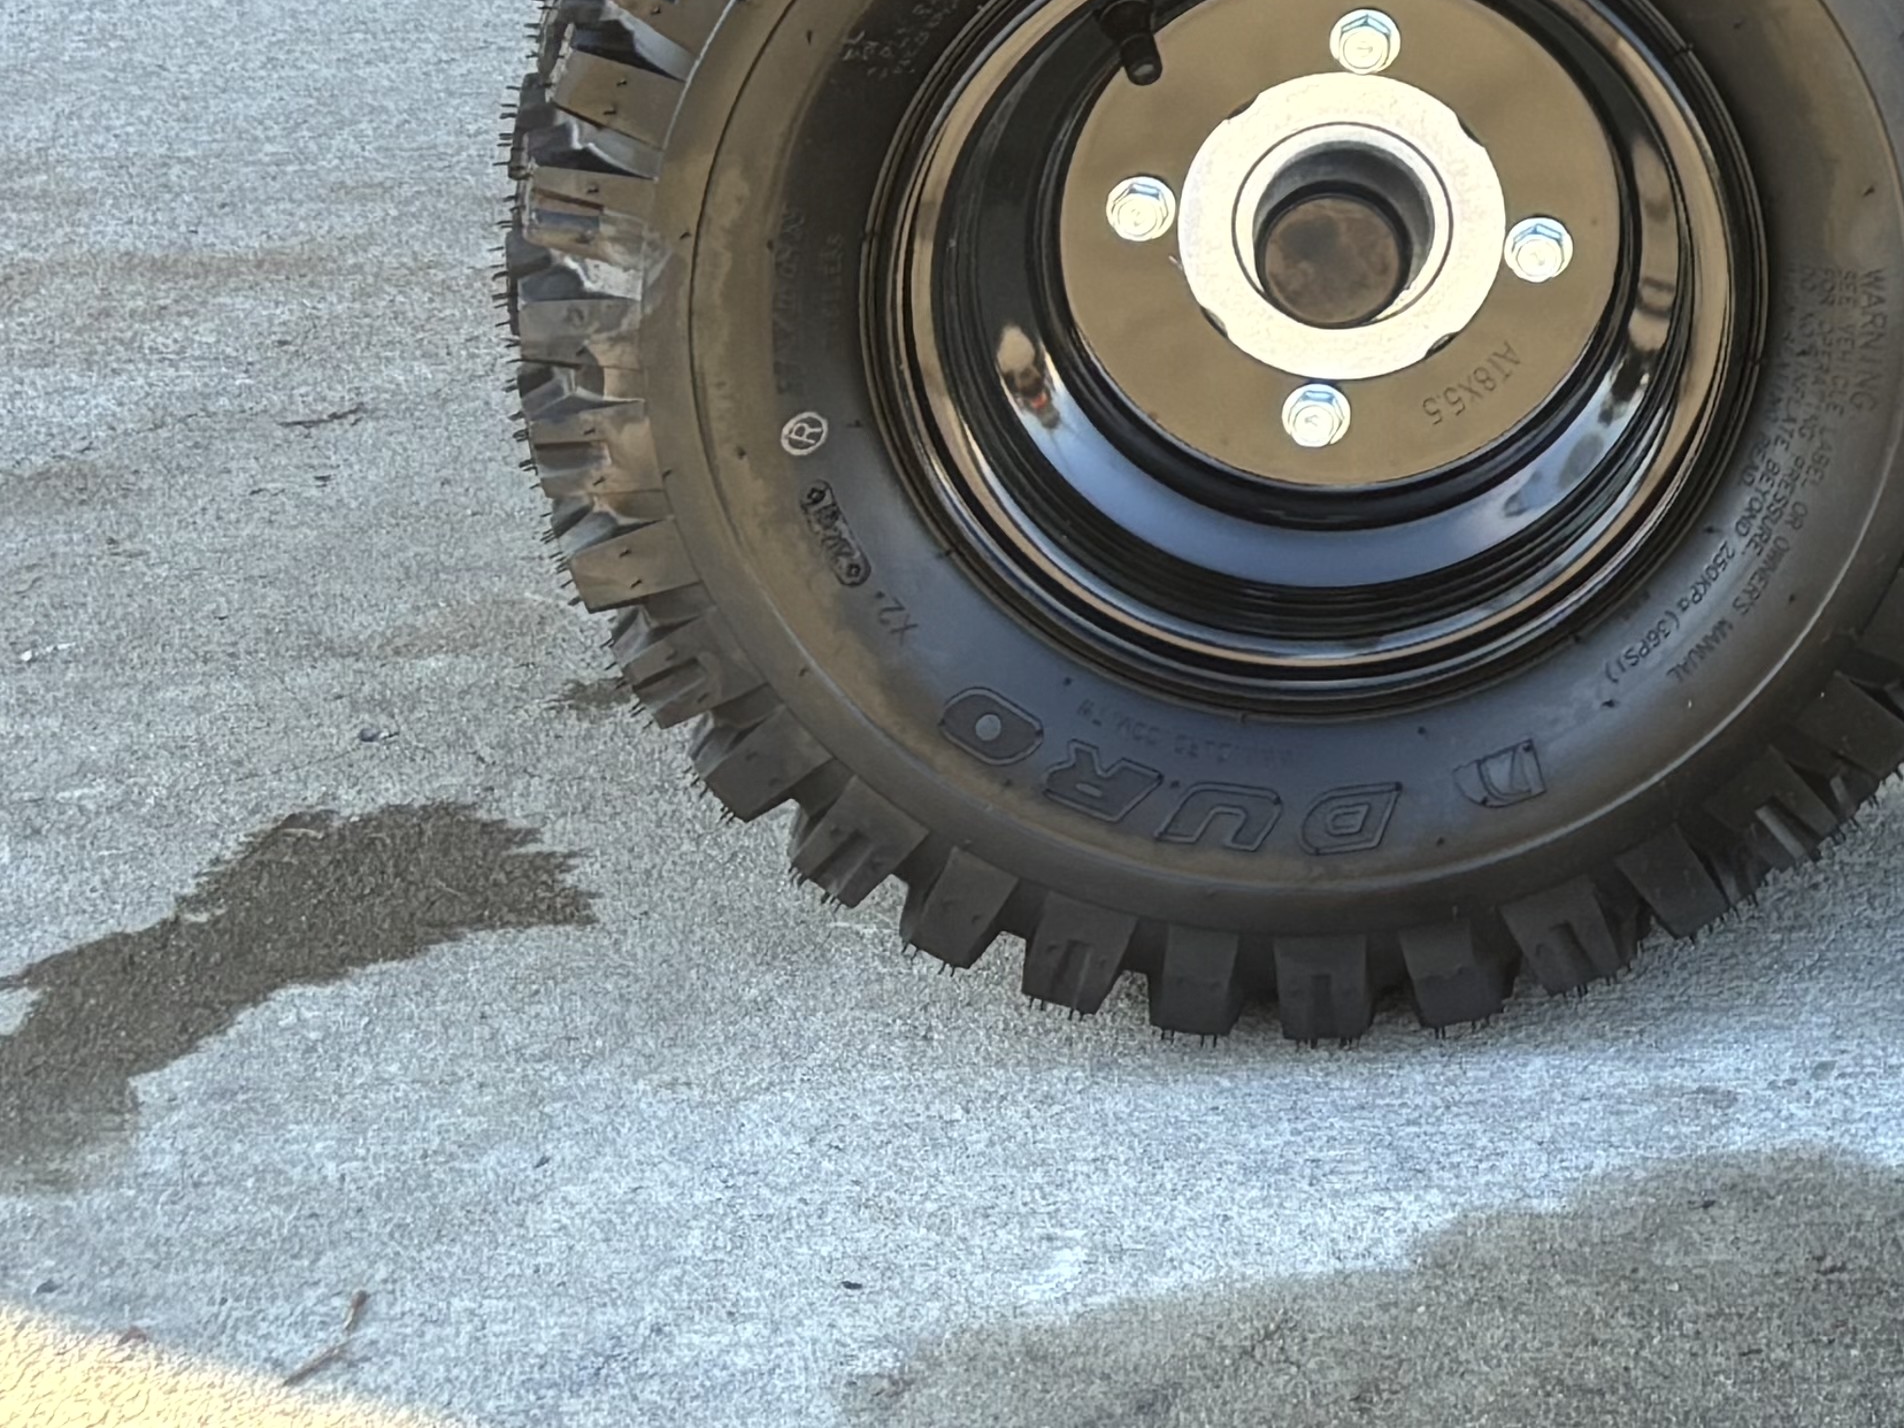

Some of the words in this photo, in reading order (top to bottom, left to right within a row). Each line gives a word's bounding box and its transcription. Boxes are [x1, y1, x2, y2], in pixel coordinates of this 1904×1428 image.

[1817, 268, 1835, 306] FOR
[1835, 267, 1858, 309] SEE
[1822, 322, 1858, 418] VEHICLE
[1855, 268, 1888, 414] WARNING
[1417, 339, 1523, 426] AT8X5.5
[1730, 458, 1783, 539] BEYOND
[1798, 427, 1840, 492] LABEL
[1781, 499, 1812, 533] OR
[1727, 533, 1796, 617] OWNER'S
[1662, 615, 1738, 687] MANUAL
[939, 685, 1403, 856] DURO
